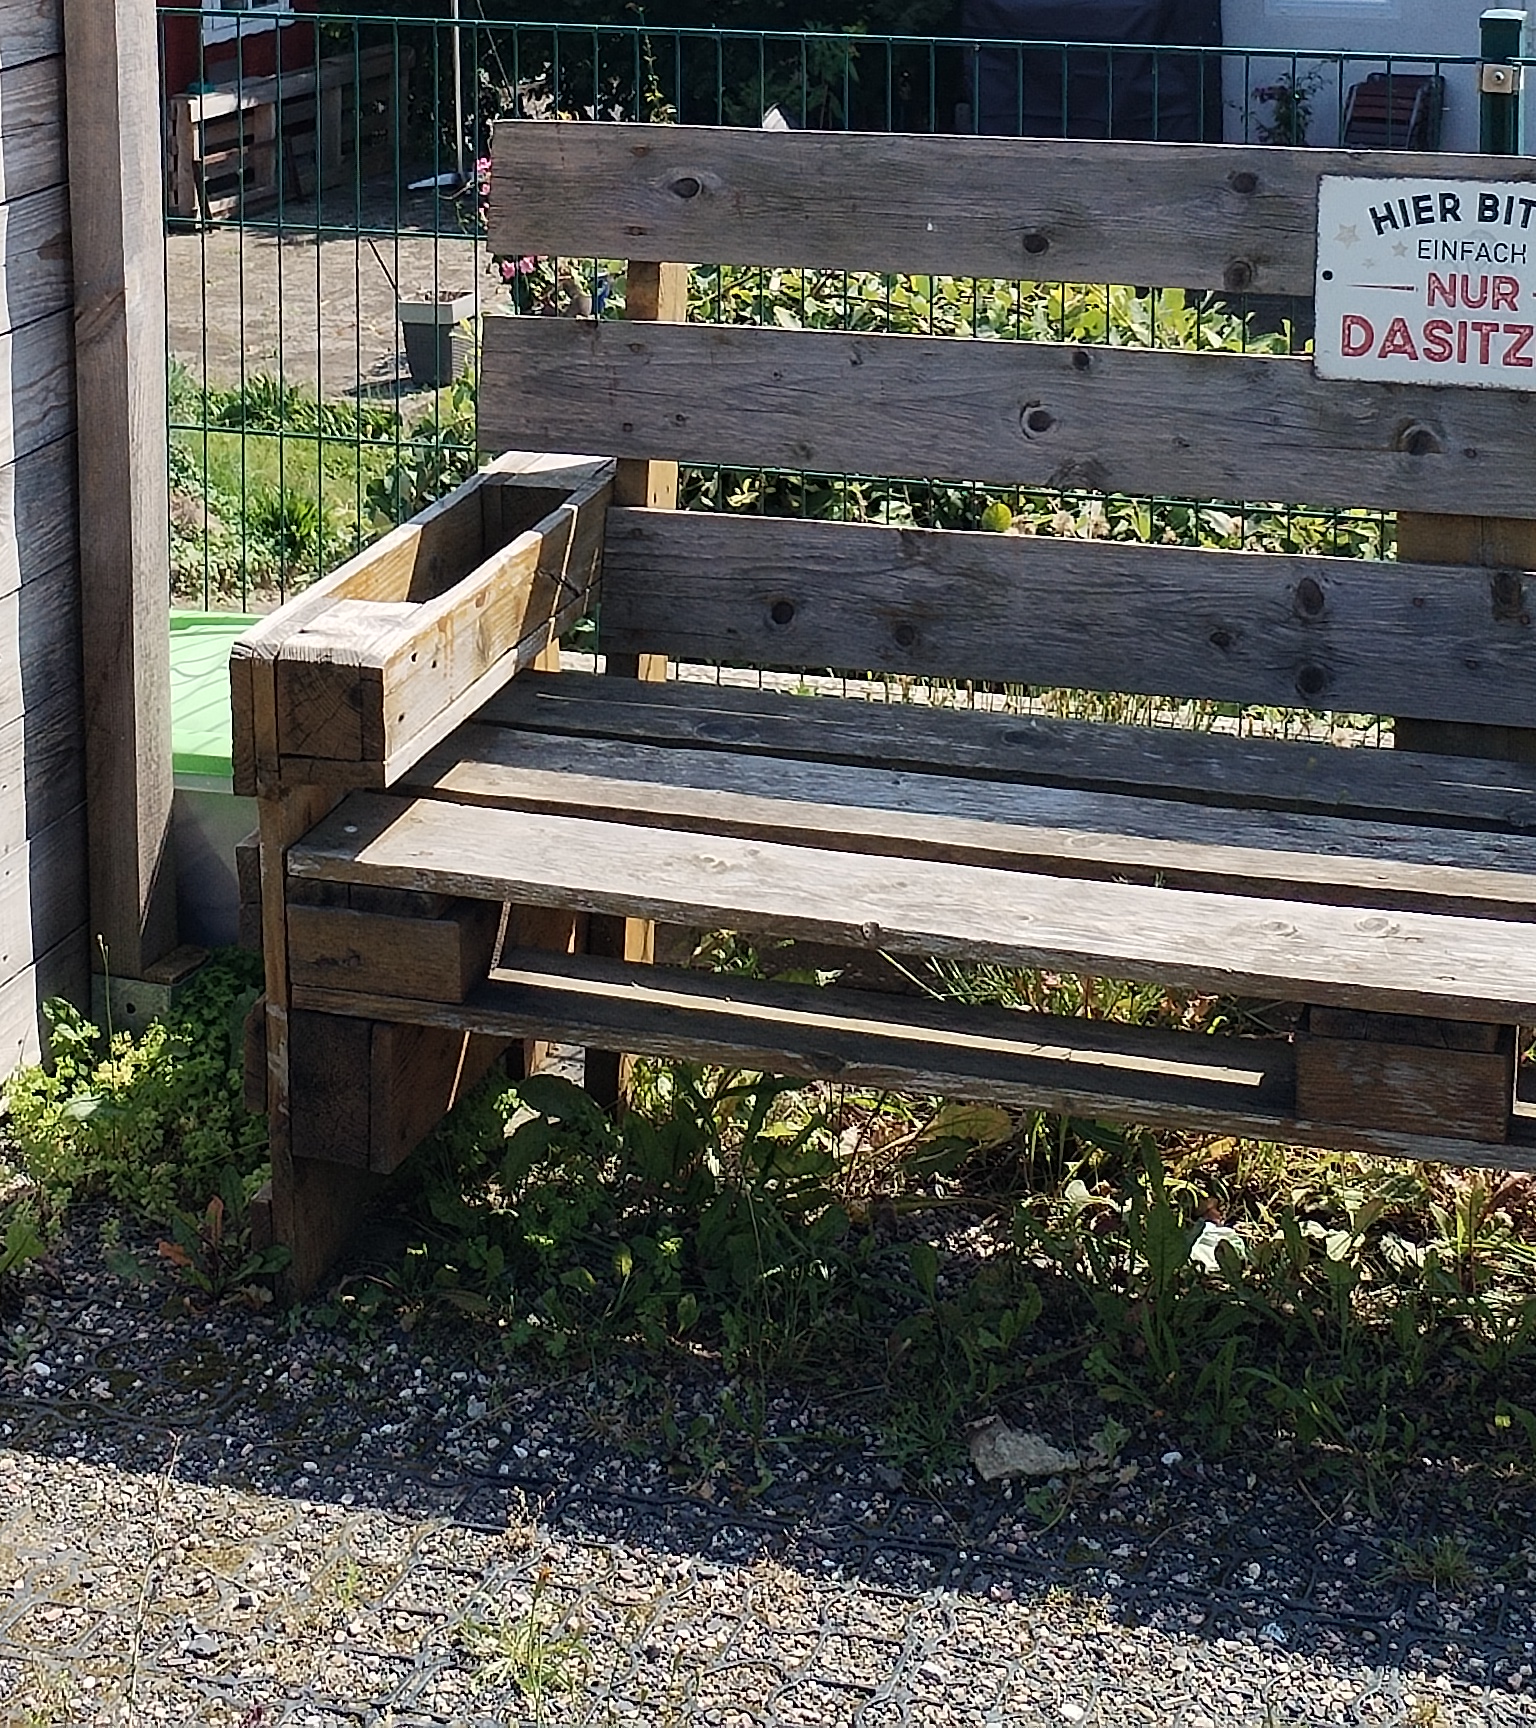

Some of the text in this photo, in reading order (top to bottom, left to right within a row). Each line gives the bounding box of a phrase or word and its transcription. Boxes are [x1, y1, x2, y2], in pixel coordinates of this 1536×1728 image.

[1369, 192, 1461, 237] HIER
[1417, 239, 1527, 265] EINFACH
[1427, 272, 1520, 312] NUR
